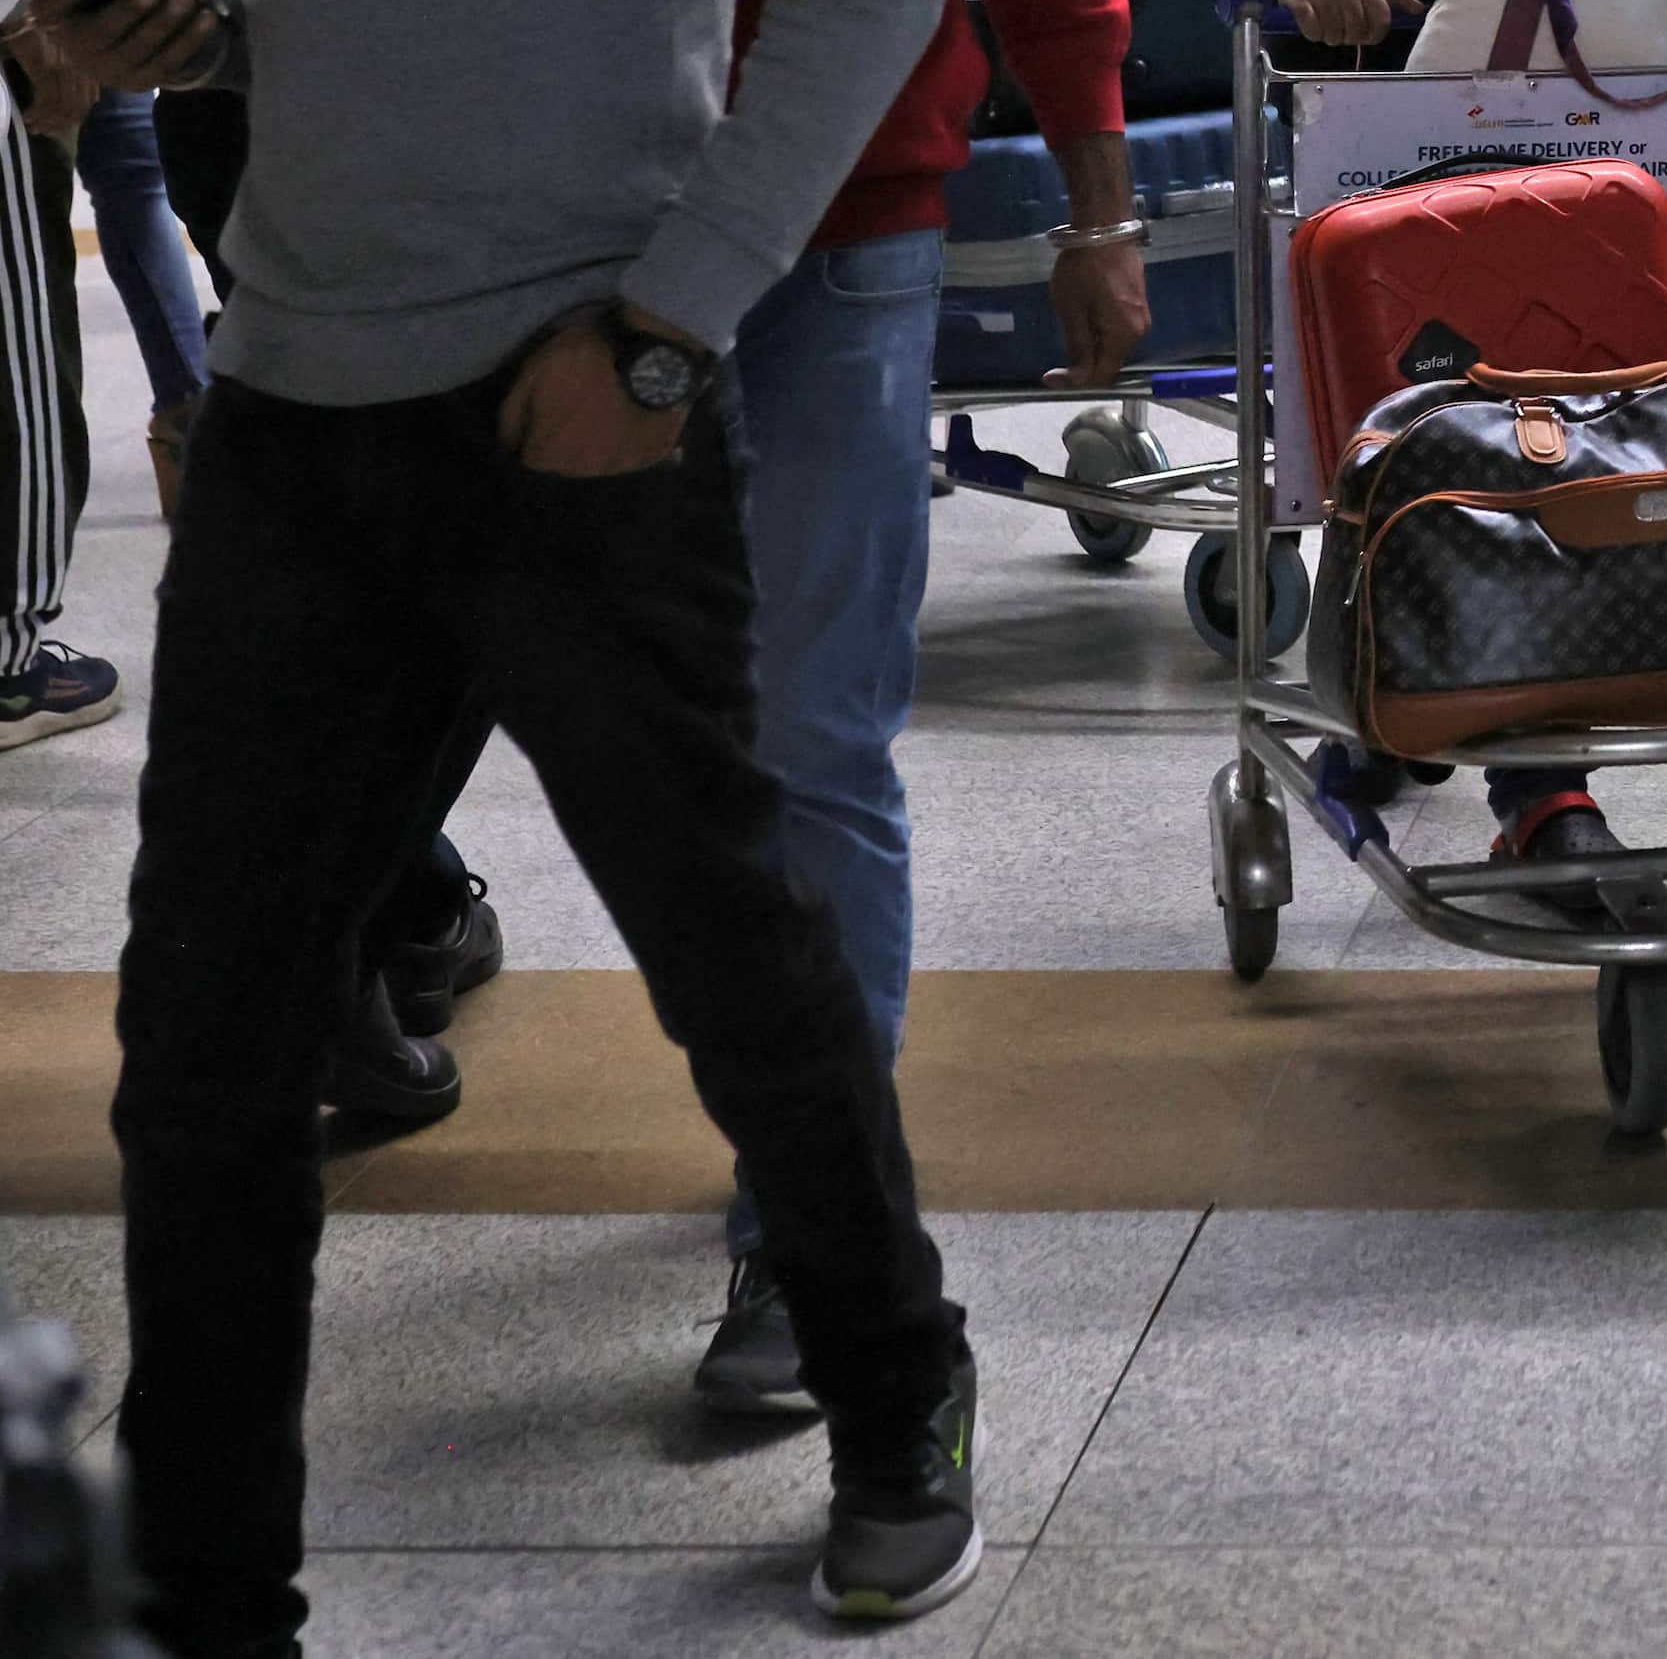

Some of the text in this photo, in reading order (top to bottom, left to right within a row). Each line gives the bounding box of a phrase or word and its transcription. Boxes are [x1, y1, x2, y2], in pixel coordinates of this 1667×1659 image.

[1468, 143, 1527, 158] HOME
[1531, 140, 1623, 158] DELIVERY
[1629, 142, 1648, 155] or
[1337, 169, 1410, 187] COLLE
[1415, 351, 1454, 373] safari
